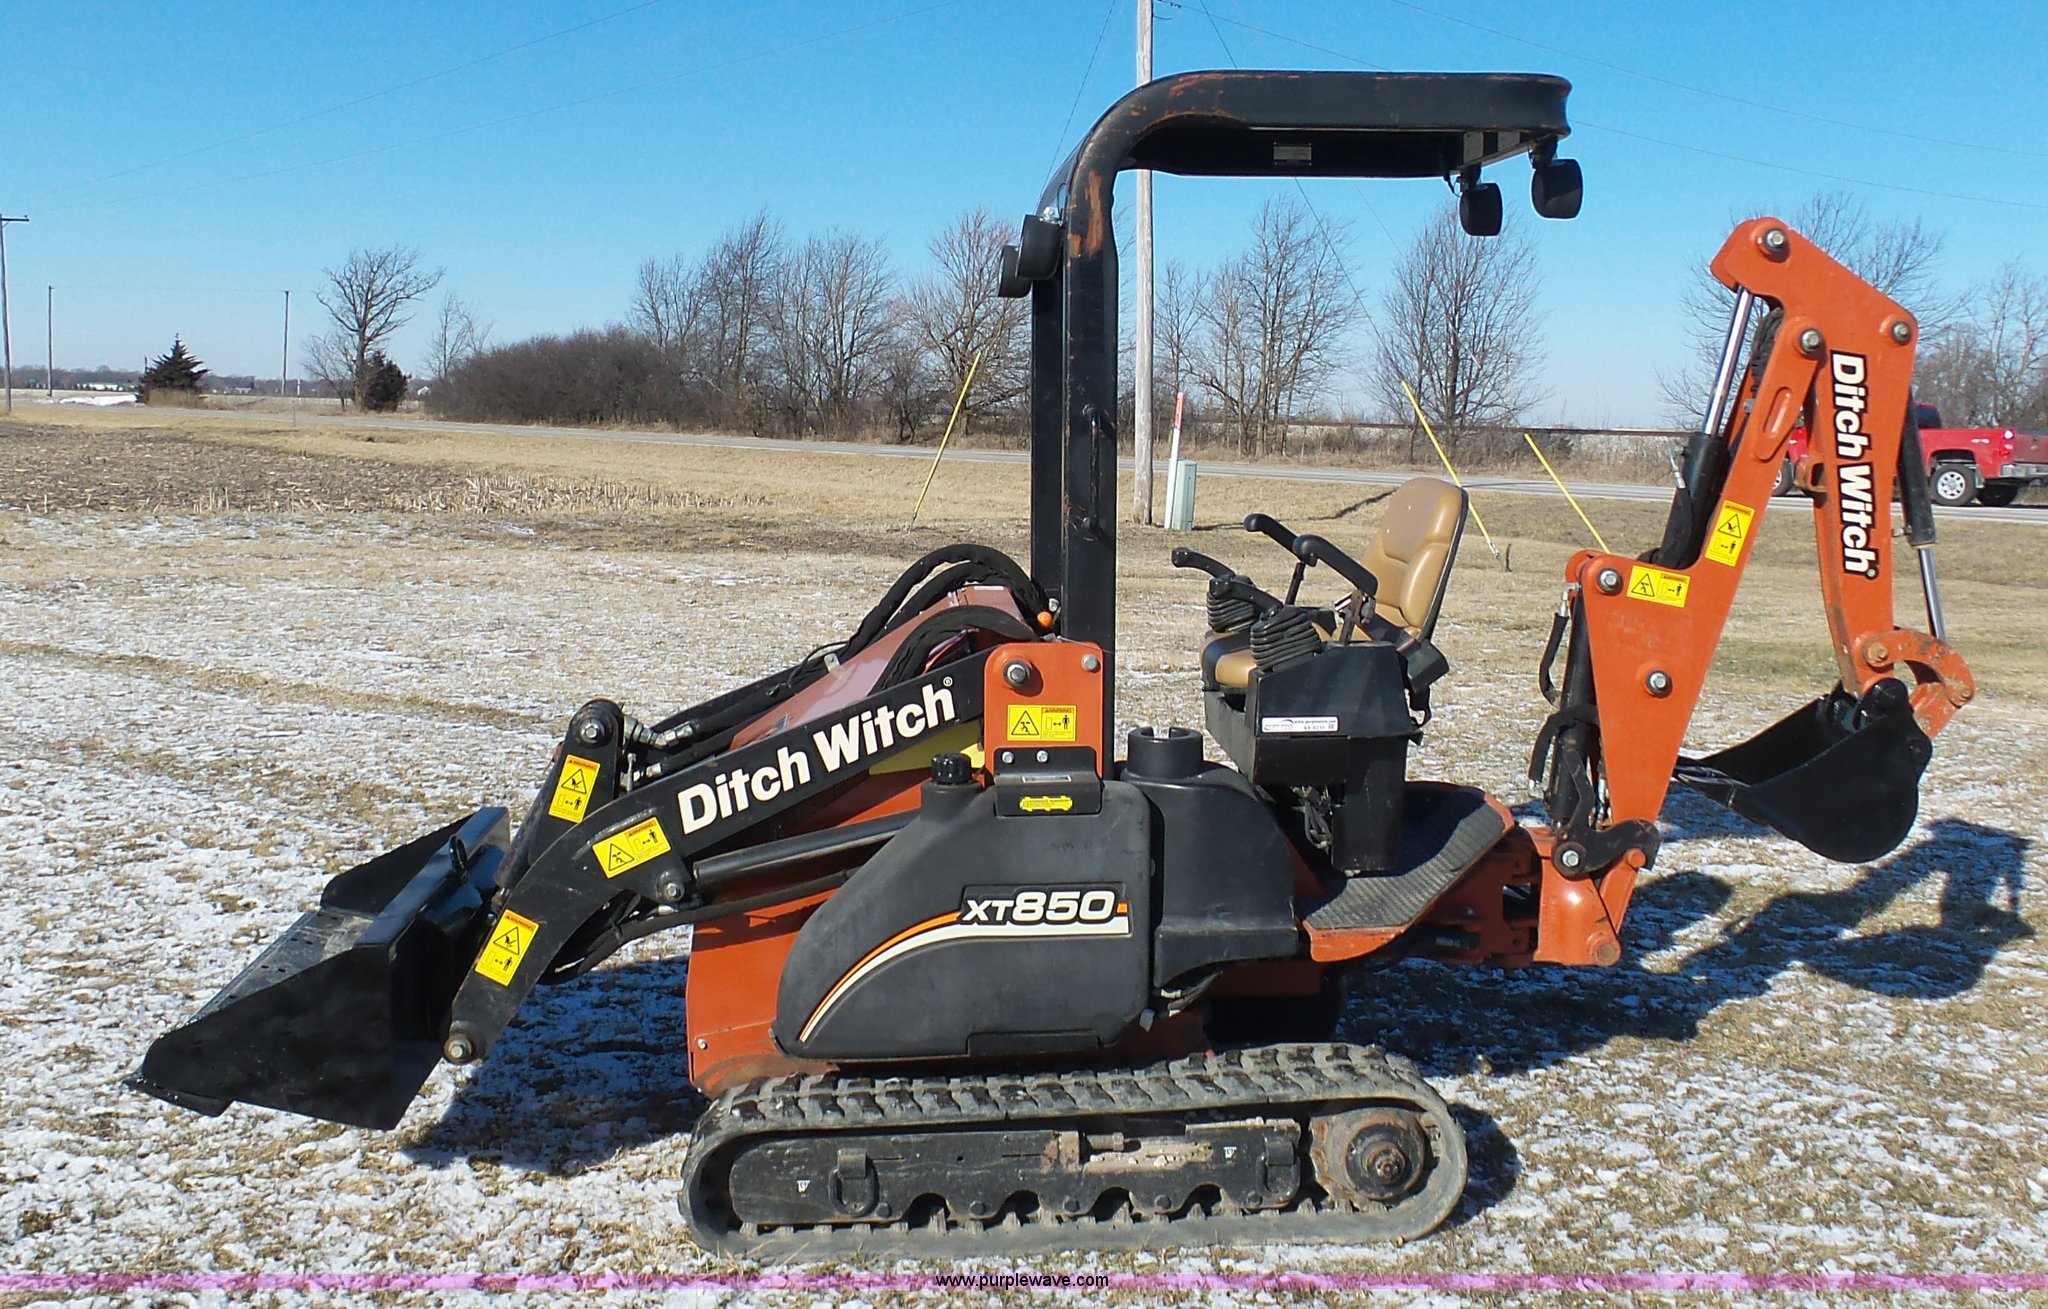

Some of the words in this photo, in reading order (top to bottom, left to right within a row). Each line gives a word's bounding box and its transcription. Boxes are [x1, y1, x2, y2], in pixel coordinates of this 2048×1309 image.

[1832, 353, 1872, 459] Ditch
[677, 746, 811, 835] Ditch
[962, 890, 1116, 922] XT850
